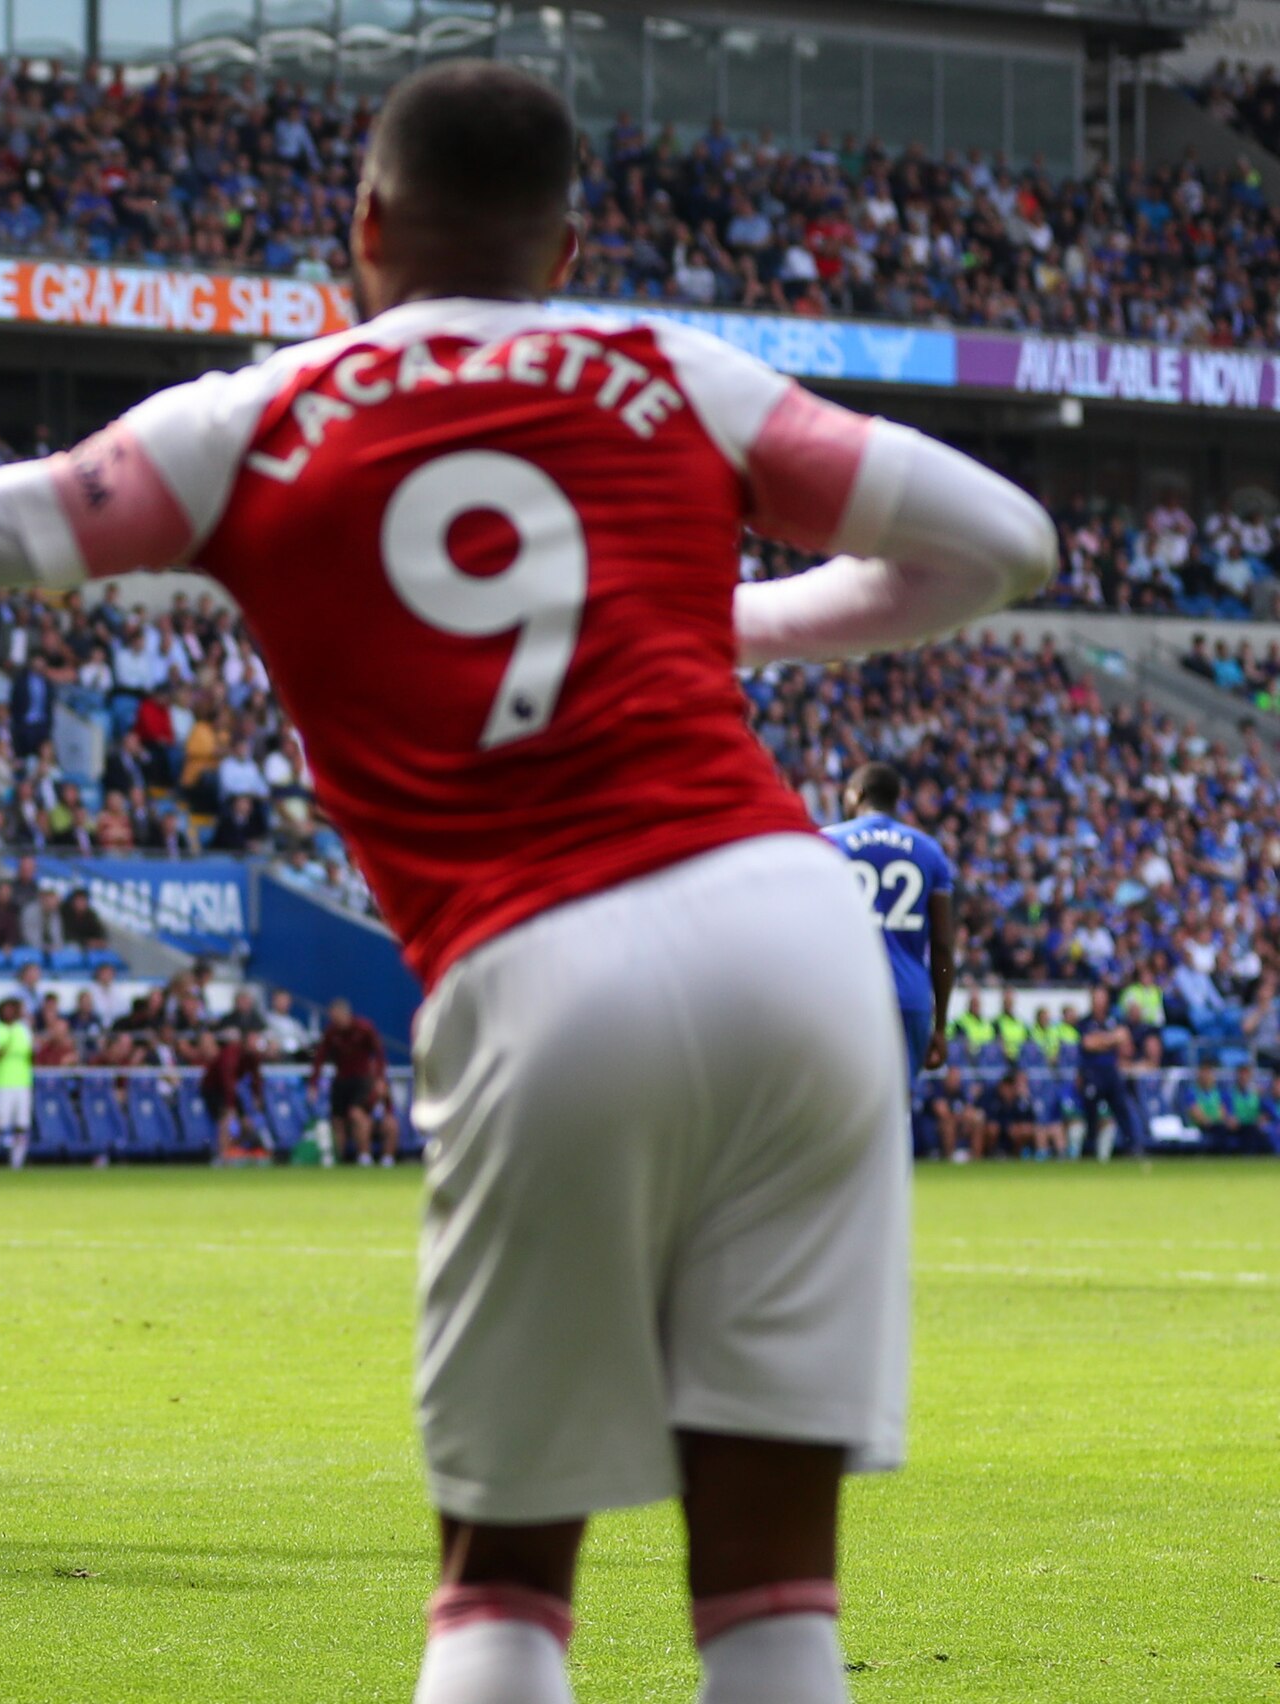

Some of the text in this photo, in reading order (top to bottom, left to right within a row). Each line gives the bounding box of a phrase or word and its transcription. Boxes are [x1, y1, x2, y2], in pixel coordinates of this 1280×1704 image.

[30, 263, 219, 332] GRAZING
[229, 276, 326, 339] SHED
[248, 332, 682, 483] LACAZETTE
[1016, 336, 1184, 404] AVAILABLE
[1189, 348, 1265, 410] NOW
[380, 449, 589, 751] 9
